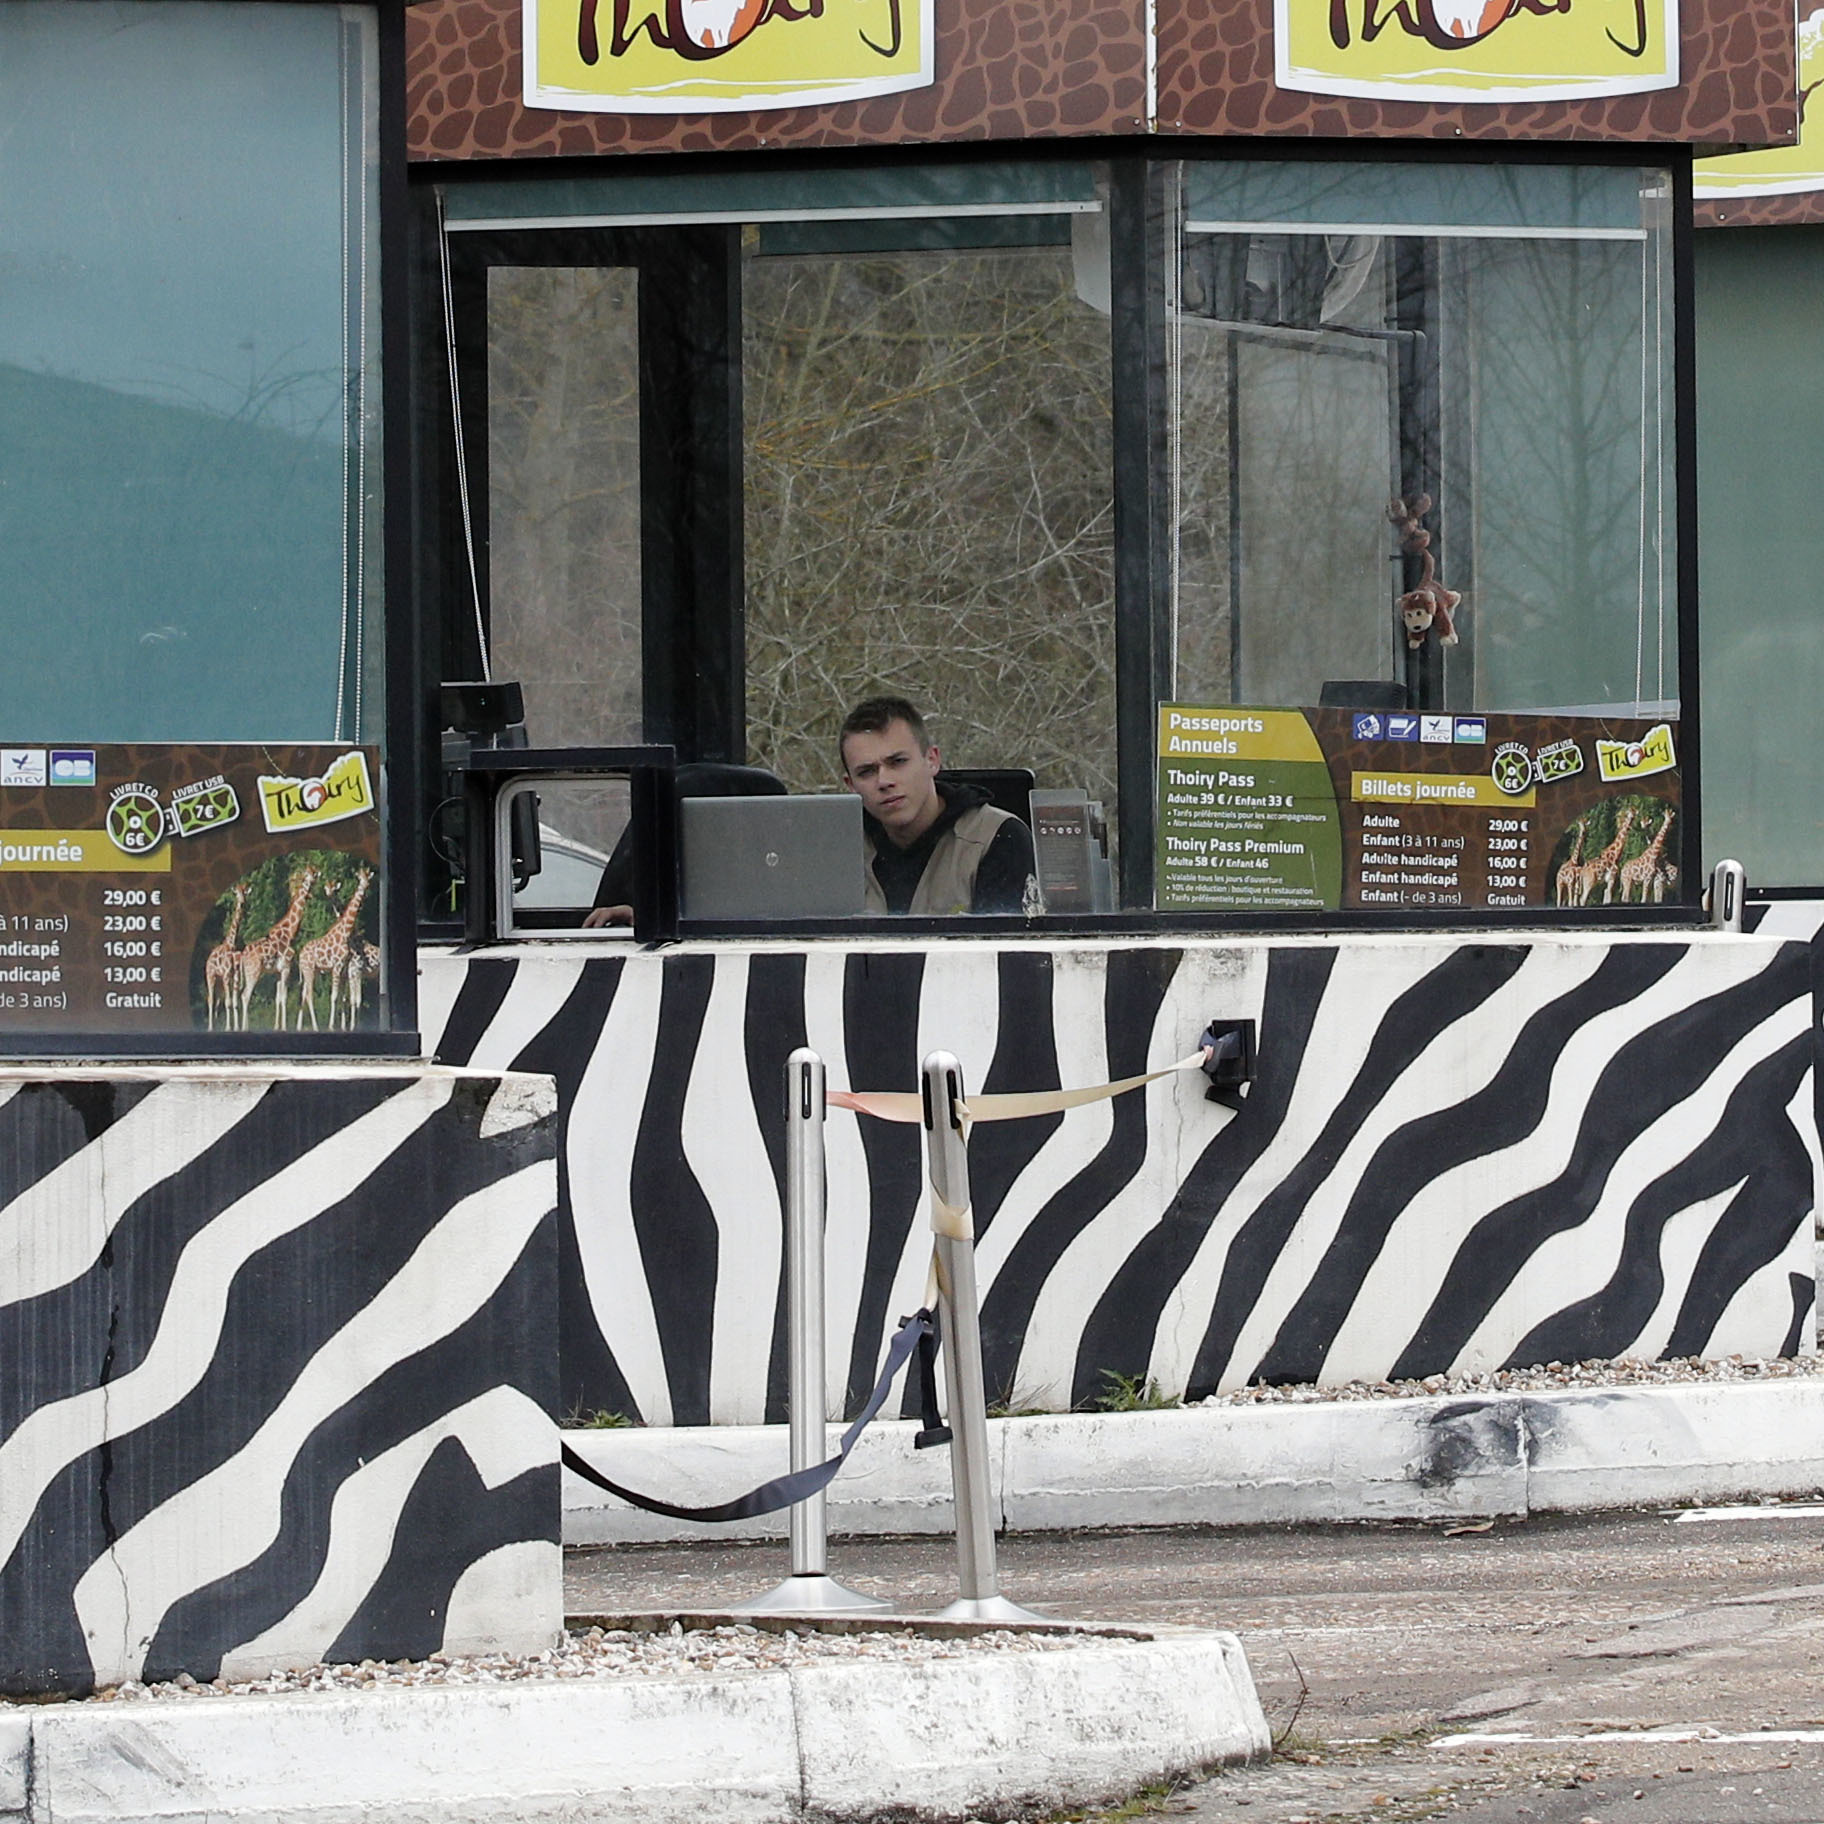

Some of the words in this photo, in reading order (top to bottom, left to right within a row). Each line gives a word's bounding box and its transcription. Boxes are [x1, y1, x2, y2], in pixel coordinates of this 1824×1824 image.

[1170, 713, 1263, 735] Passeports
[1169, 736, 1237, 753] Annuels
[1602, 740, 1669, 771] Thoiry
[172, 780, 204, 799] LIVRET
[205, 775, 224, 790] USB
[1168, 770, 1214, 789] Thoiry
[1219, 772, 1255, 787] Pass
[109, 782, 143, 800] LIVRET
[144, 785, 159, 798] CD
[266, 775, 364, 818] Thoiry
[1361, 779, 1412, 796] Billets
[1416, 781, 1475, 800] journée
[1167, 794, 1198, 804] Adulte
[1200, 793, 1214, 805] 39
[1235, 795, 1266, 806] Enfant
[1268, 796, 1282, 807] 33
[196, 805, 214, 818] 7€
[1363, 815, 1400, 827] Adulte
[1489, 819, 1518, 832] 29,00
[126, 833, 145, 846] 6€
[1166, 837, 1206, 854] Thoiry
[1210, 838, 1241, 852] Pass
[1245, 839, 1304, 854] Premium
[1362, 834, 1400, 846] Enfant
[1402, 835, 1412, 848] (3
[1426, 837, 1437, 847] 11
[1441, 836, 1465, 850] ans)
[1488, 838, 1518, 851] 23,00
[1166, 857, 1193, 866] Adulte
[1195, 857, 1207, 866] 58
[1226, 858, 1254, 868] Enfant
[1255, 858, 1269, 868] 46
[1362, 853, 1398, 865] Adulte
[1401, 854, 1458, 869] handicapé
[1488, 857, 1517, 870] 16,00
[1361, 871, 1398, 883] Enfant
[1401, 873, 1458, 887] handicapé
[1488, 875, 1517, 888] 13,00
[104, 891, 146, 907] 29,00
[151, 891, 161, 905] €
[1361, 890, 1398, 902] Enfant
[1413, 891, 1426, 903] de
[1429, 892, 1435, 903] 3
[1438, 892, 1461, 905] ans)
[1488, 894, 1526, 906] Gratuit
[12, 916, 28, 930] 11
[35, 915, 69, 932] ans)
[104, 916, 146, 933] 23,00
[151, 916, 161, 930] €
[104, 942, 146, 959] 16,00
[151, 942, 161, 956] €
[104, 967, 146, 984] 13,00
[151, 967, 161, 982] €
[20, 993, 29, 1008] 3
[34, 992, 67, 1010] ans)
[106, 993, 161, 1008] Gratuit
